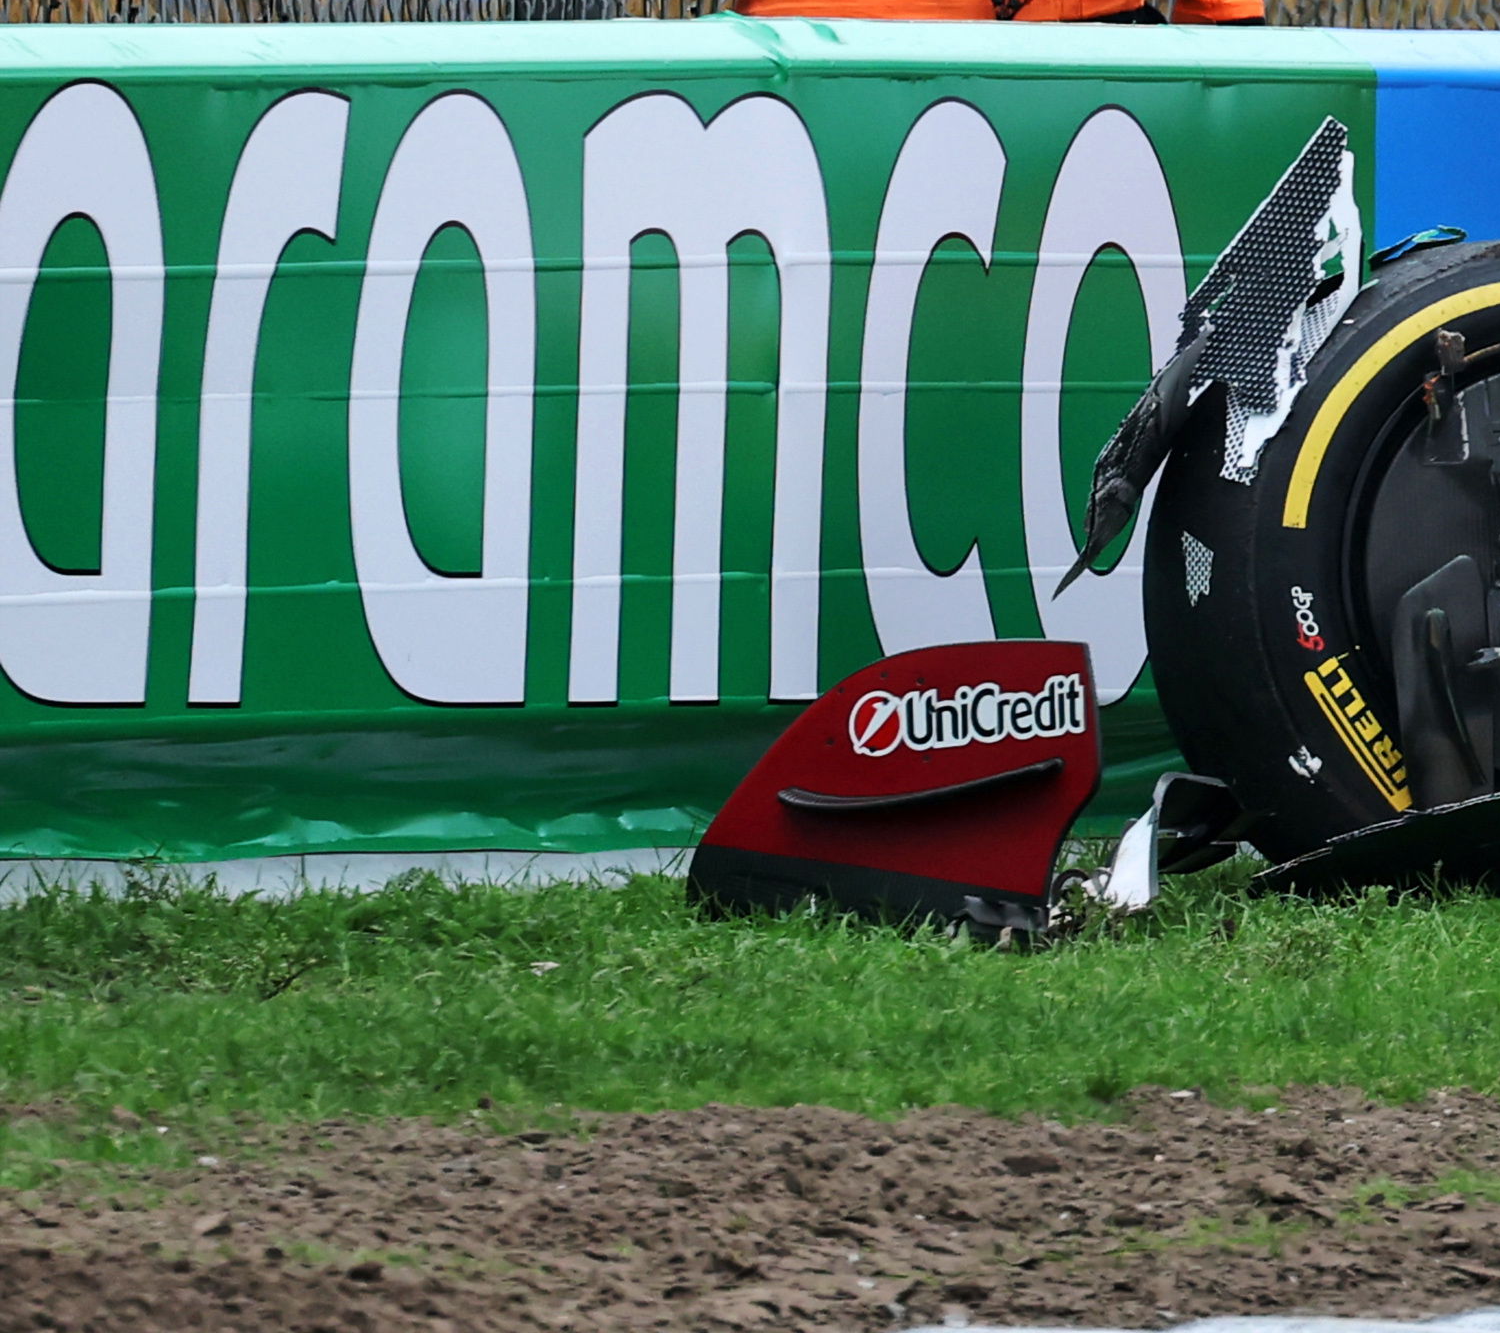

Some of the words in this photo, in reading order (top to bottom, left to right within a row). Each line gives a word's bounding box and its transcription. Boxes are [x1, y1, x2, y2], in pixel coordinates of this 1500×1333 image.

[0, 76, 1188, 707] aramco
[903, 677, 1083, 747] UniCredit
[1303, 645, 1414, 813] PIRELLI
